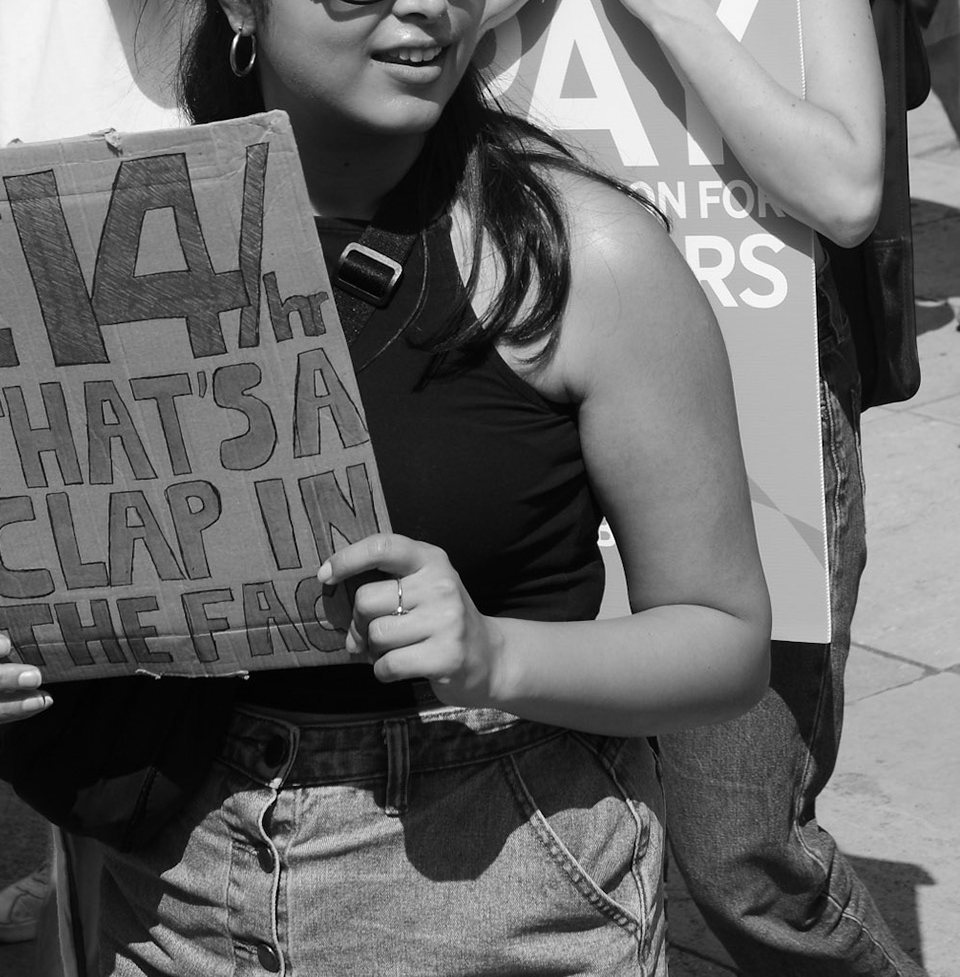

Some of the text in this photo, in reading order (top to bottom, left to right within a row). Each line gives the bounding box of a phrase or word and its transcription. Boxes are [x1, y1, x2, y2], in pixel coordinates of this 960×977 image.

[293, 347, 370, 459] A
[254, 463, 380, 571] IN
[181, 574, 354, 663] FAC
